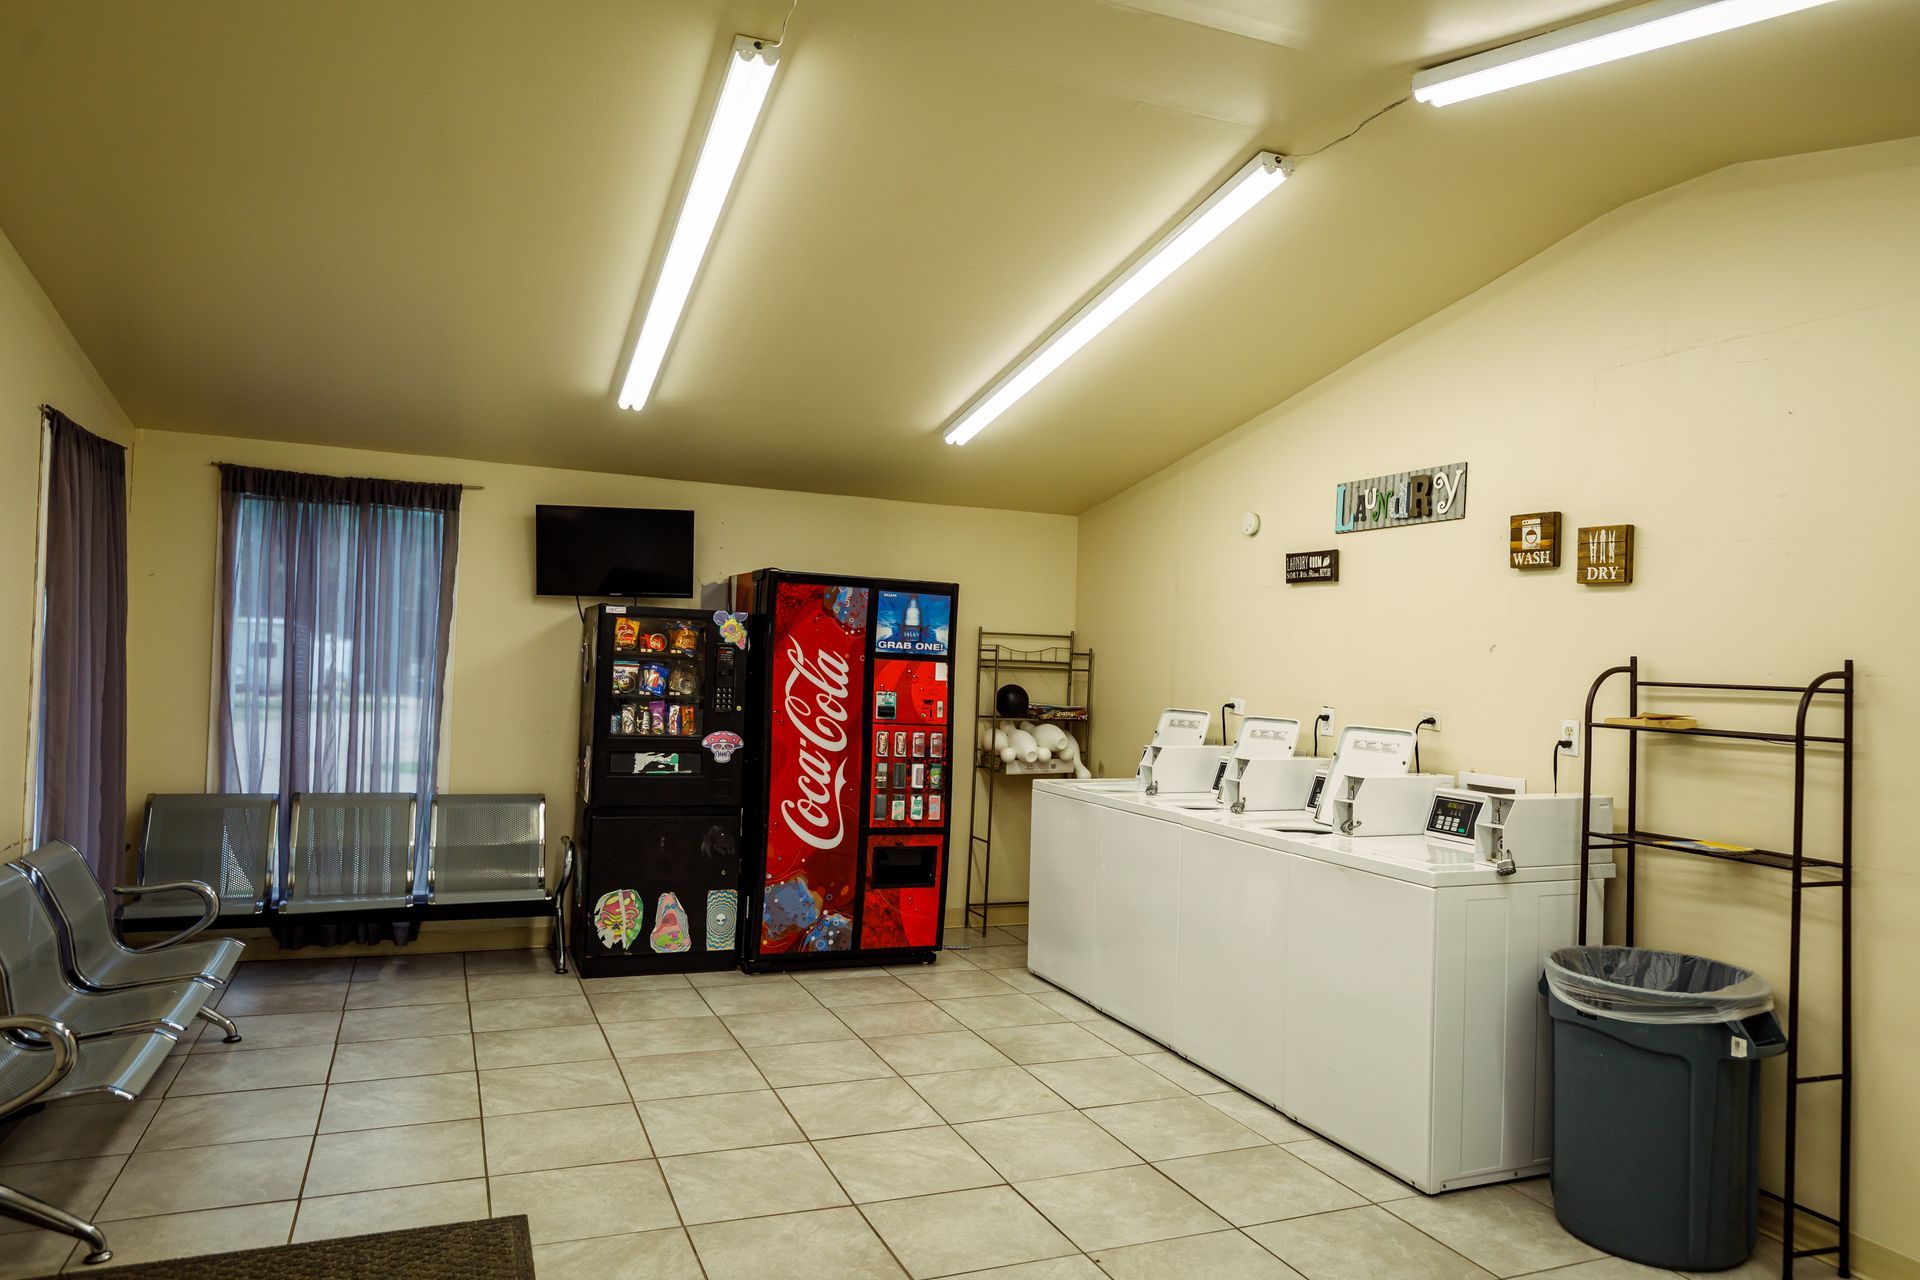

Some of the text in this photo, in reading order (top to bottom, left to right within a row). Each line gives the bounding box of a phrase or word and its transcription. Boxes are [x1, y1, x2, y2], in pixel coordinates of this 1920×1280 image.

[1512, 550, 1551, 566] WASH
[1586, 566, 1619, 580] DRY
[878, 640, 944, 651] GRAB ONE!
[781, 633, 850, 850] Coca-Cola
